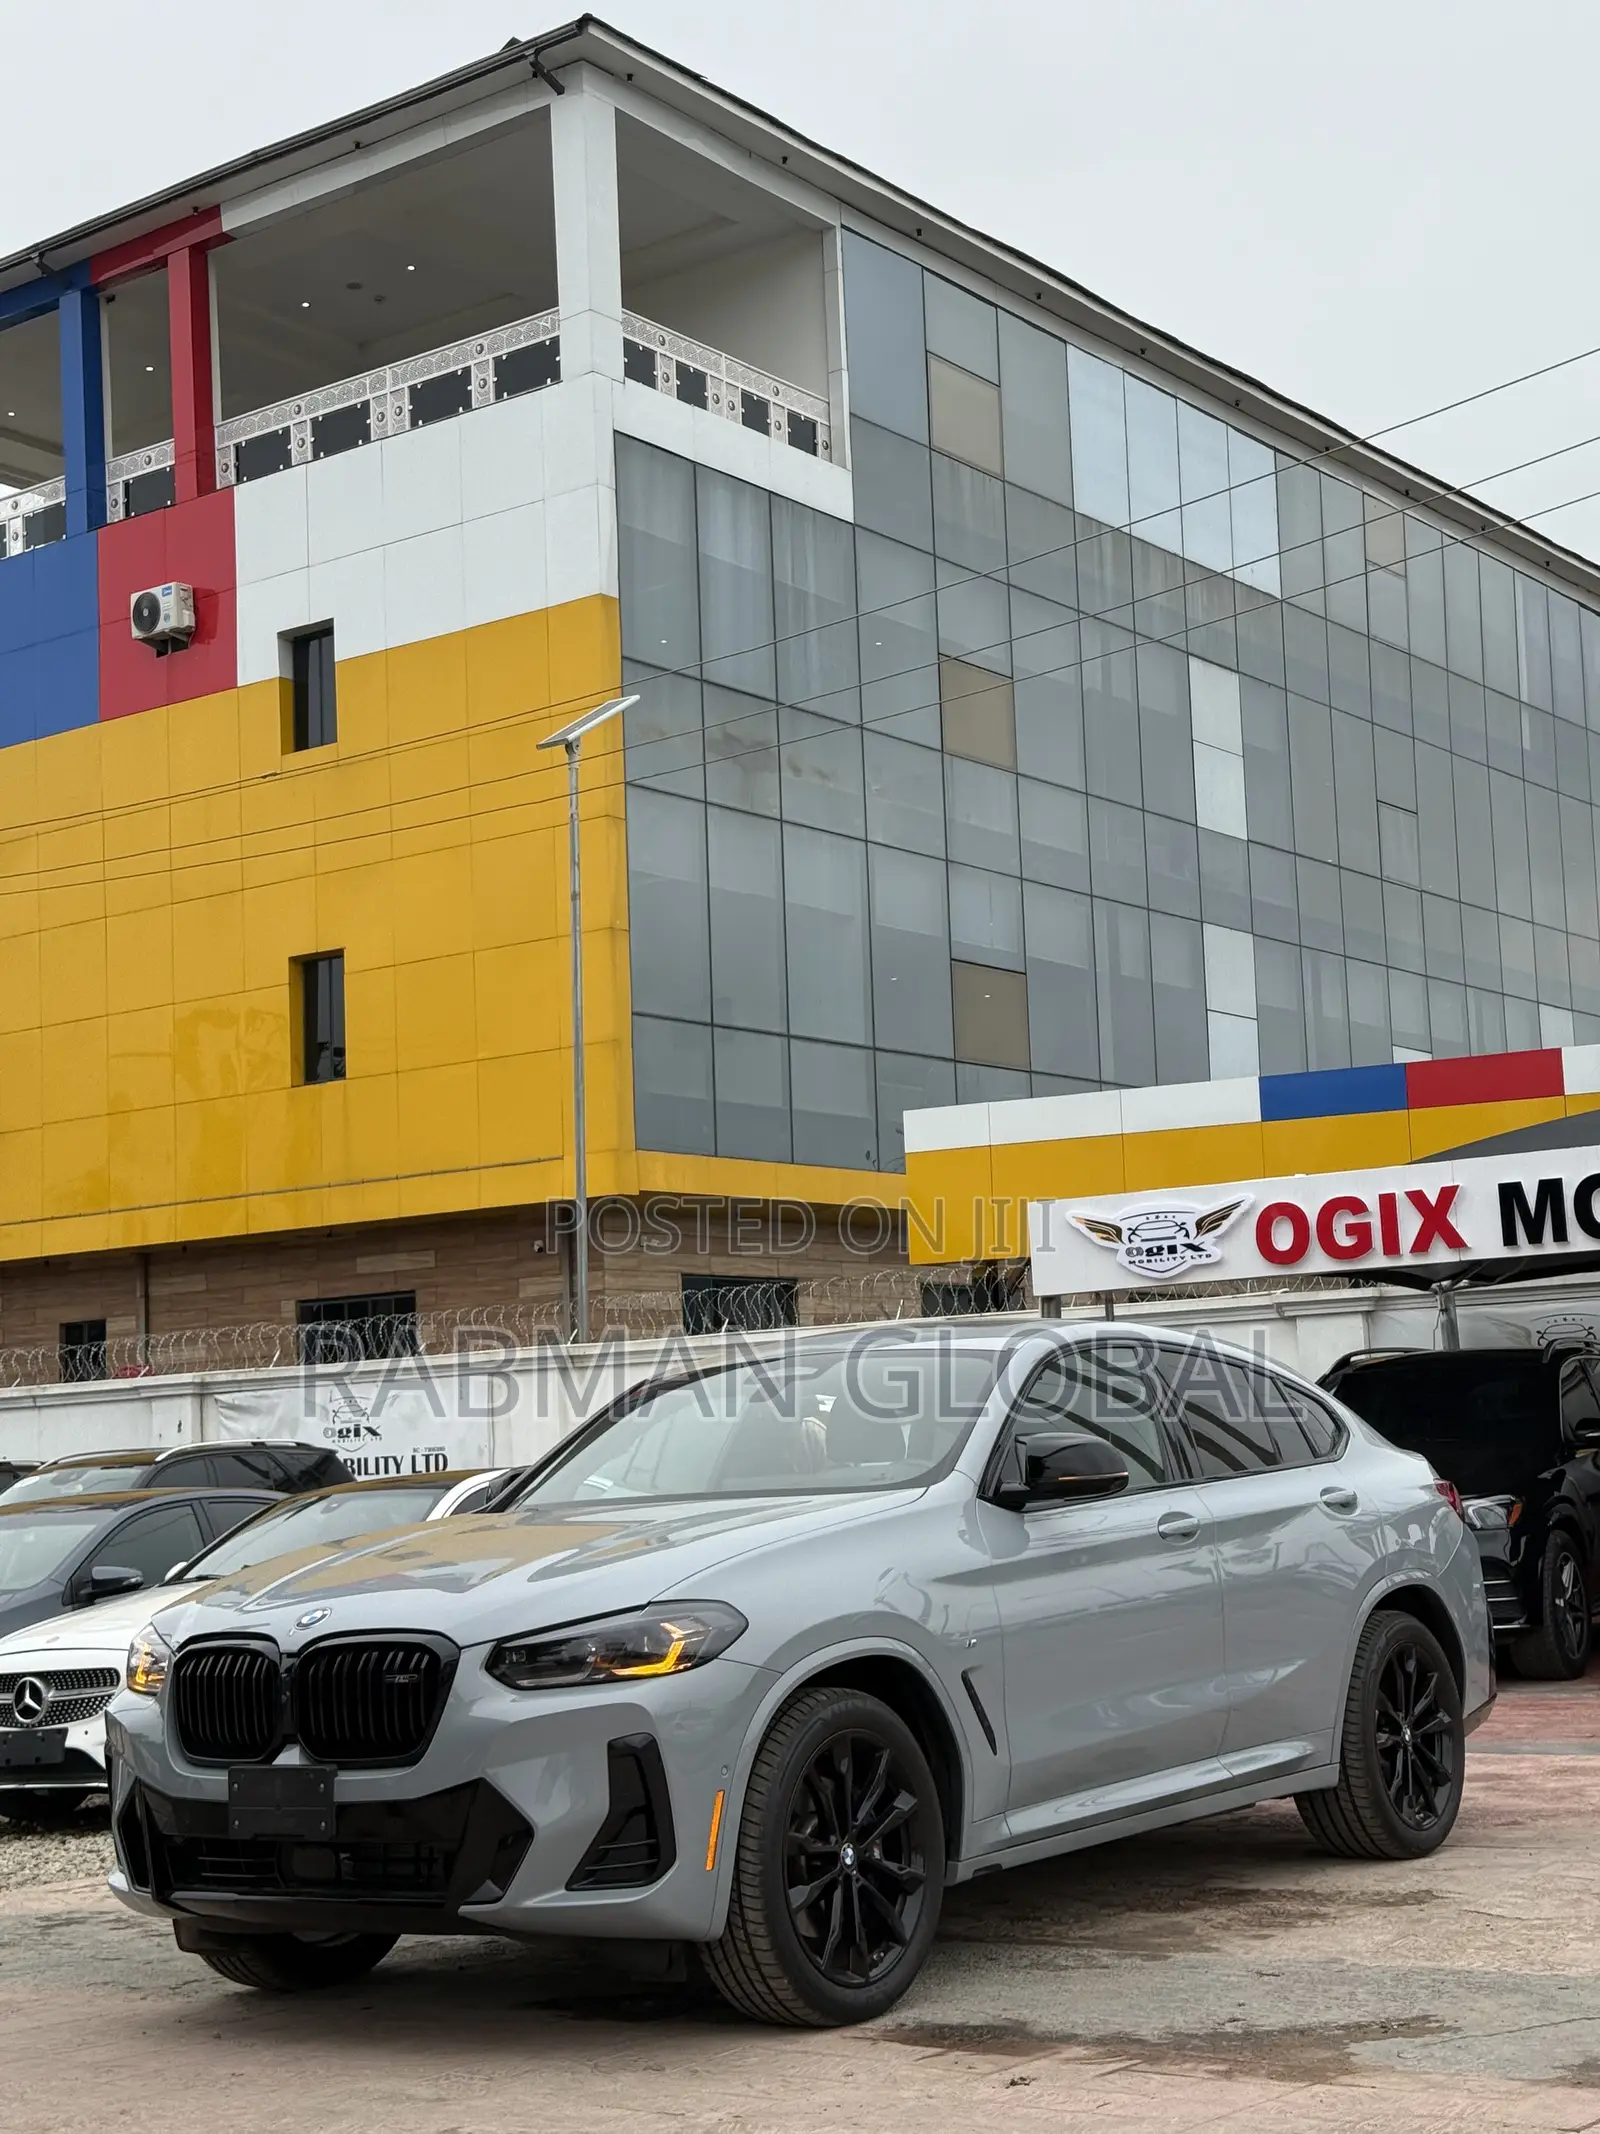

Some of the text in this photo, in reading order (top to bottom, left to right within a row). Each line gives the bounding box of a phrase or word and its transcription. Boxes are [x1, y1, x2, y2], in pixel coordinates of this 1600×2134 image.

[1255, 1184, 1469, 1265] OGIX
[1128, 1255, 1187, 1265] MOBILITY
[411, 1453, 449, 1474] LTD
